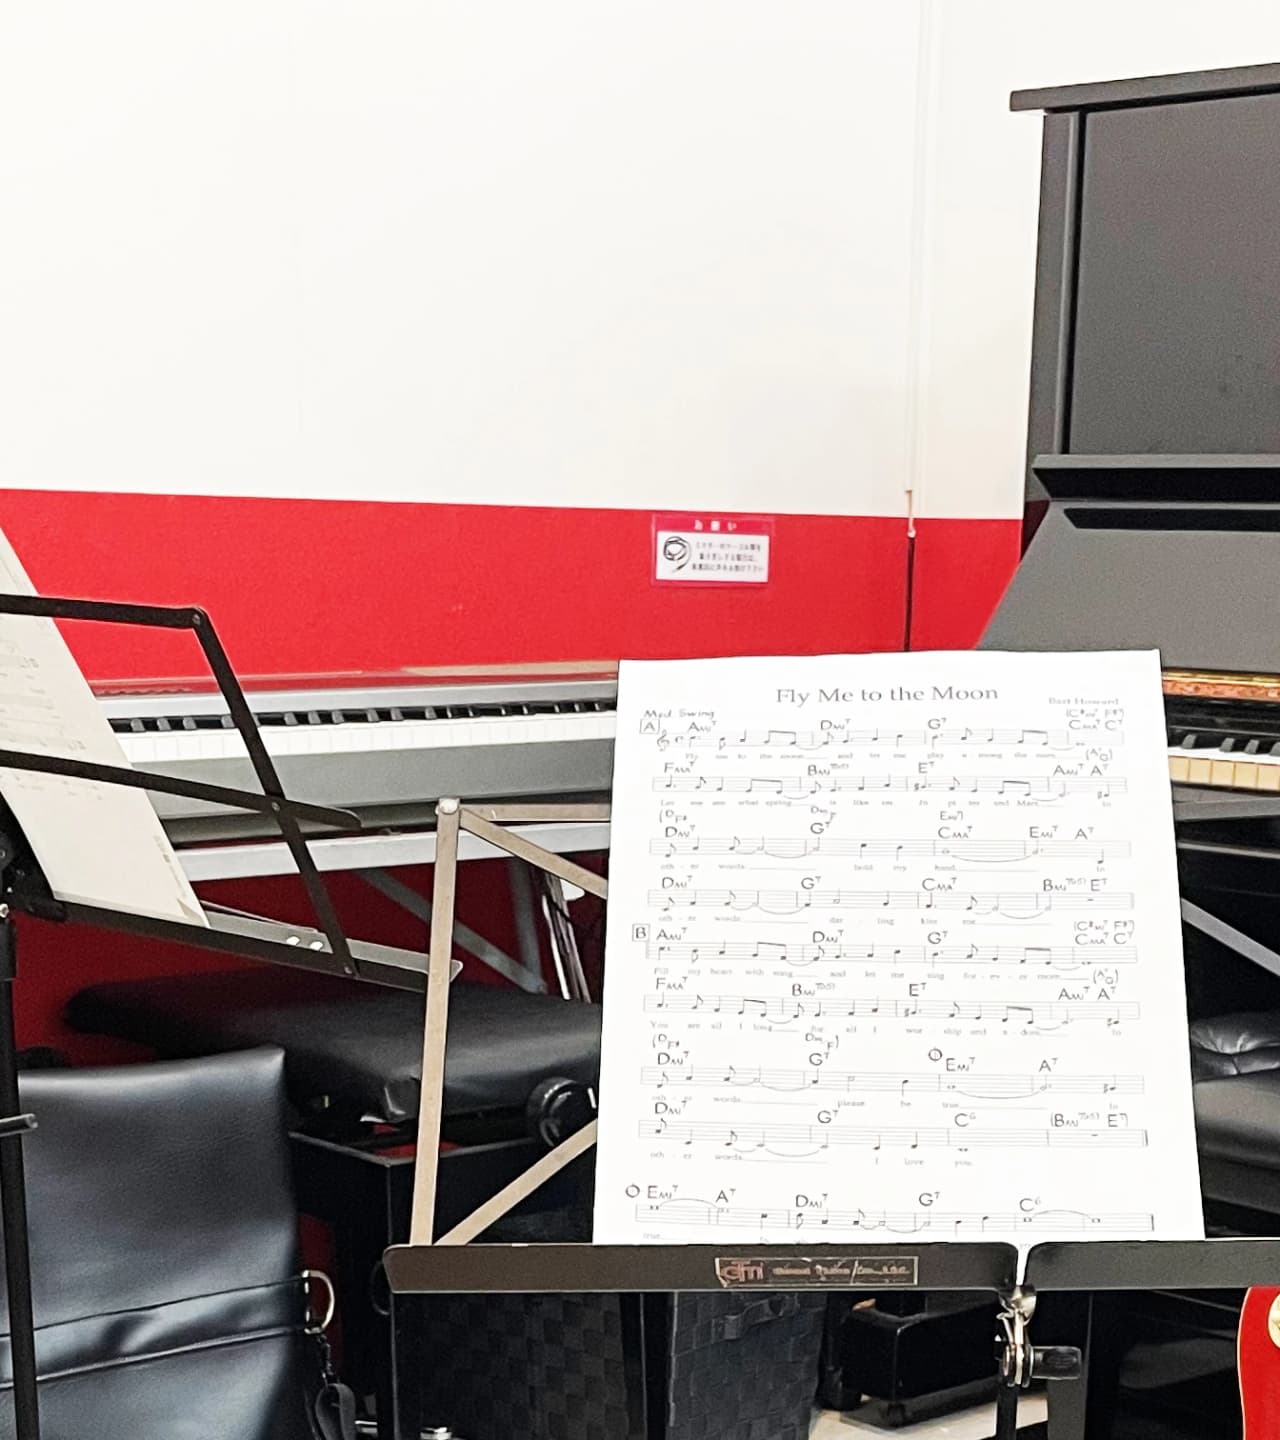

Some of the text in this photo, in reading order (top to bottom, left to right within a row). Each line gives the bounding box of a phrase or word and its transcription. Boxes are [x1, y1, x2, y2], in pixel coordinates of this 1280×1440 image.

[777, 686, 998, 708] Fly Me to the Moon
[680, 710, 715, 719] Swing
[644, 722, 655, 731] A
[635, 928, 646, 938] B
